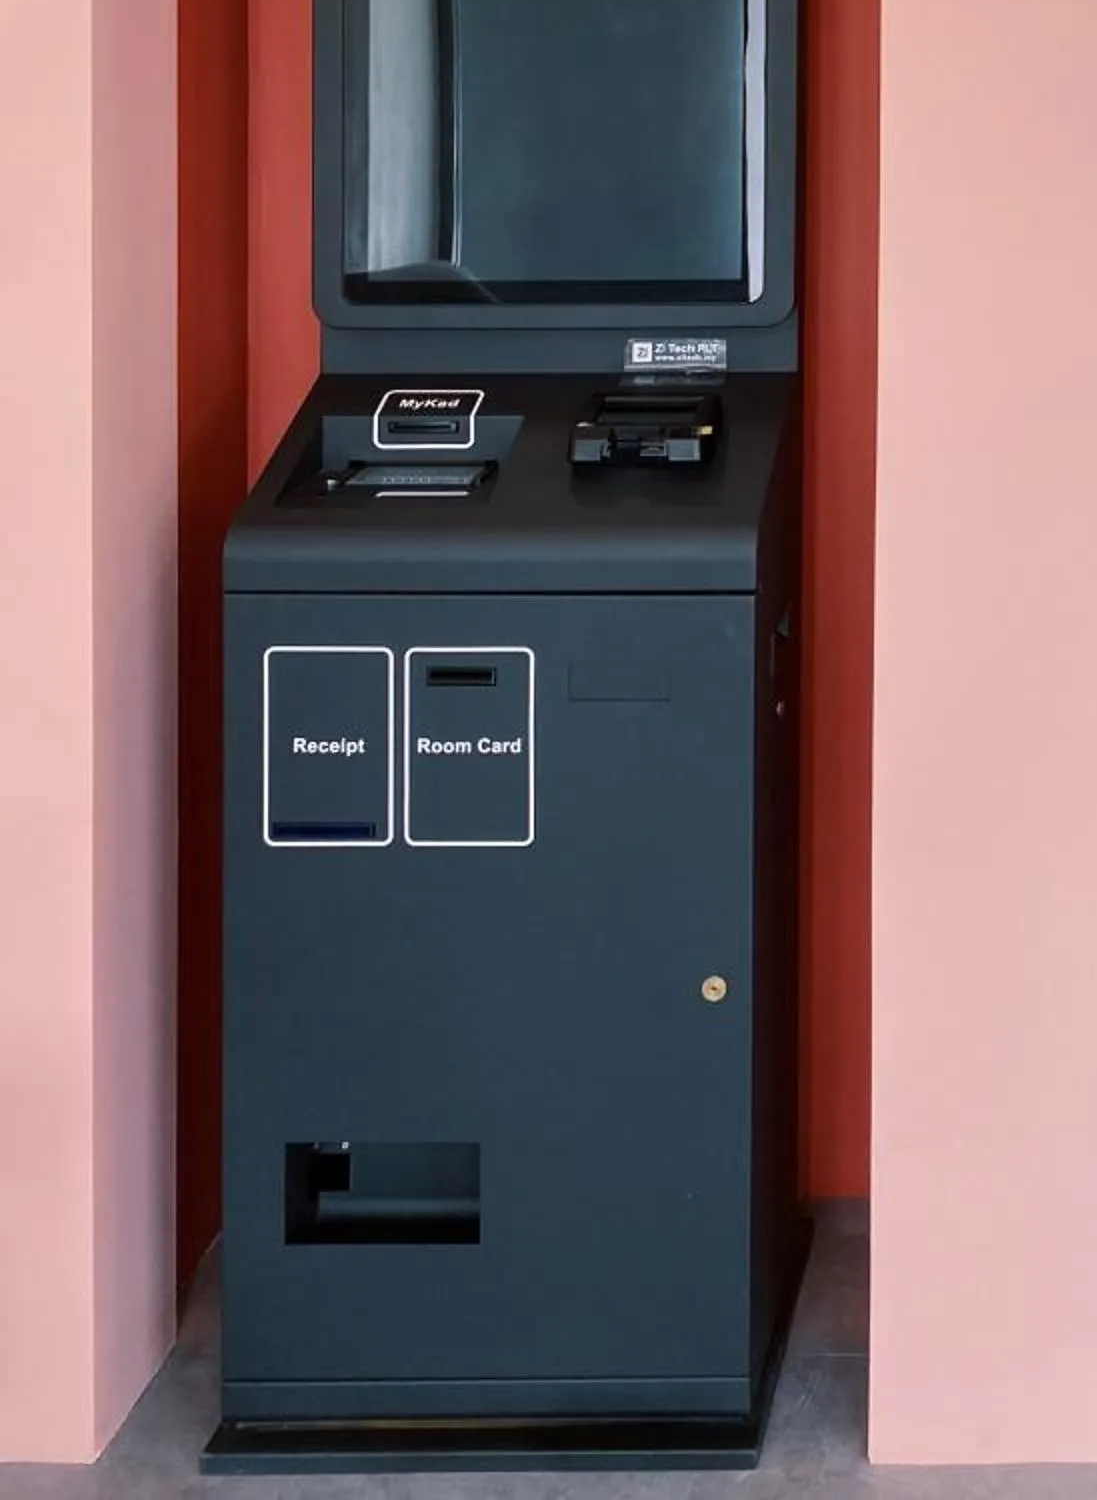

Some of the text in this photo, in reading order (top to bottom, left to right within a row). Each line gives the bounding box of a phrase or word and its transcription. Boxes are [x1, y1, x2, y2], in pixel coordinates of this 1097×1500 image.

[667, 343, 696, 354] Tech
[697, 343, 720, 354] PLT
[399, 398, 461, 410] MyKad
[292, 737, 366, 757] Receipt
[416, 737, 522, 755] Room Card
